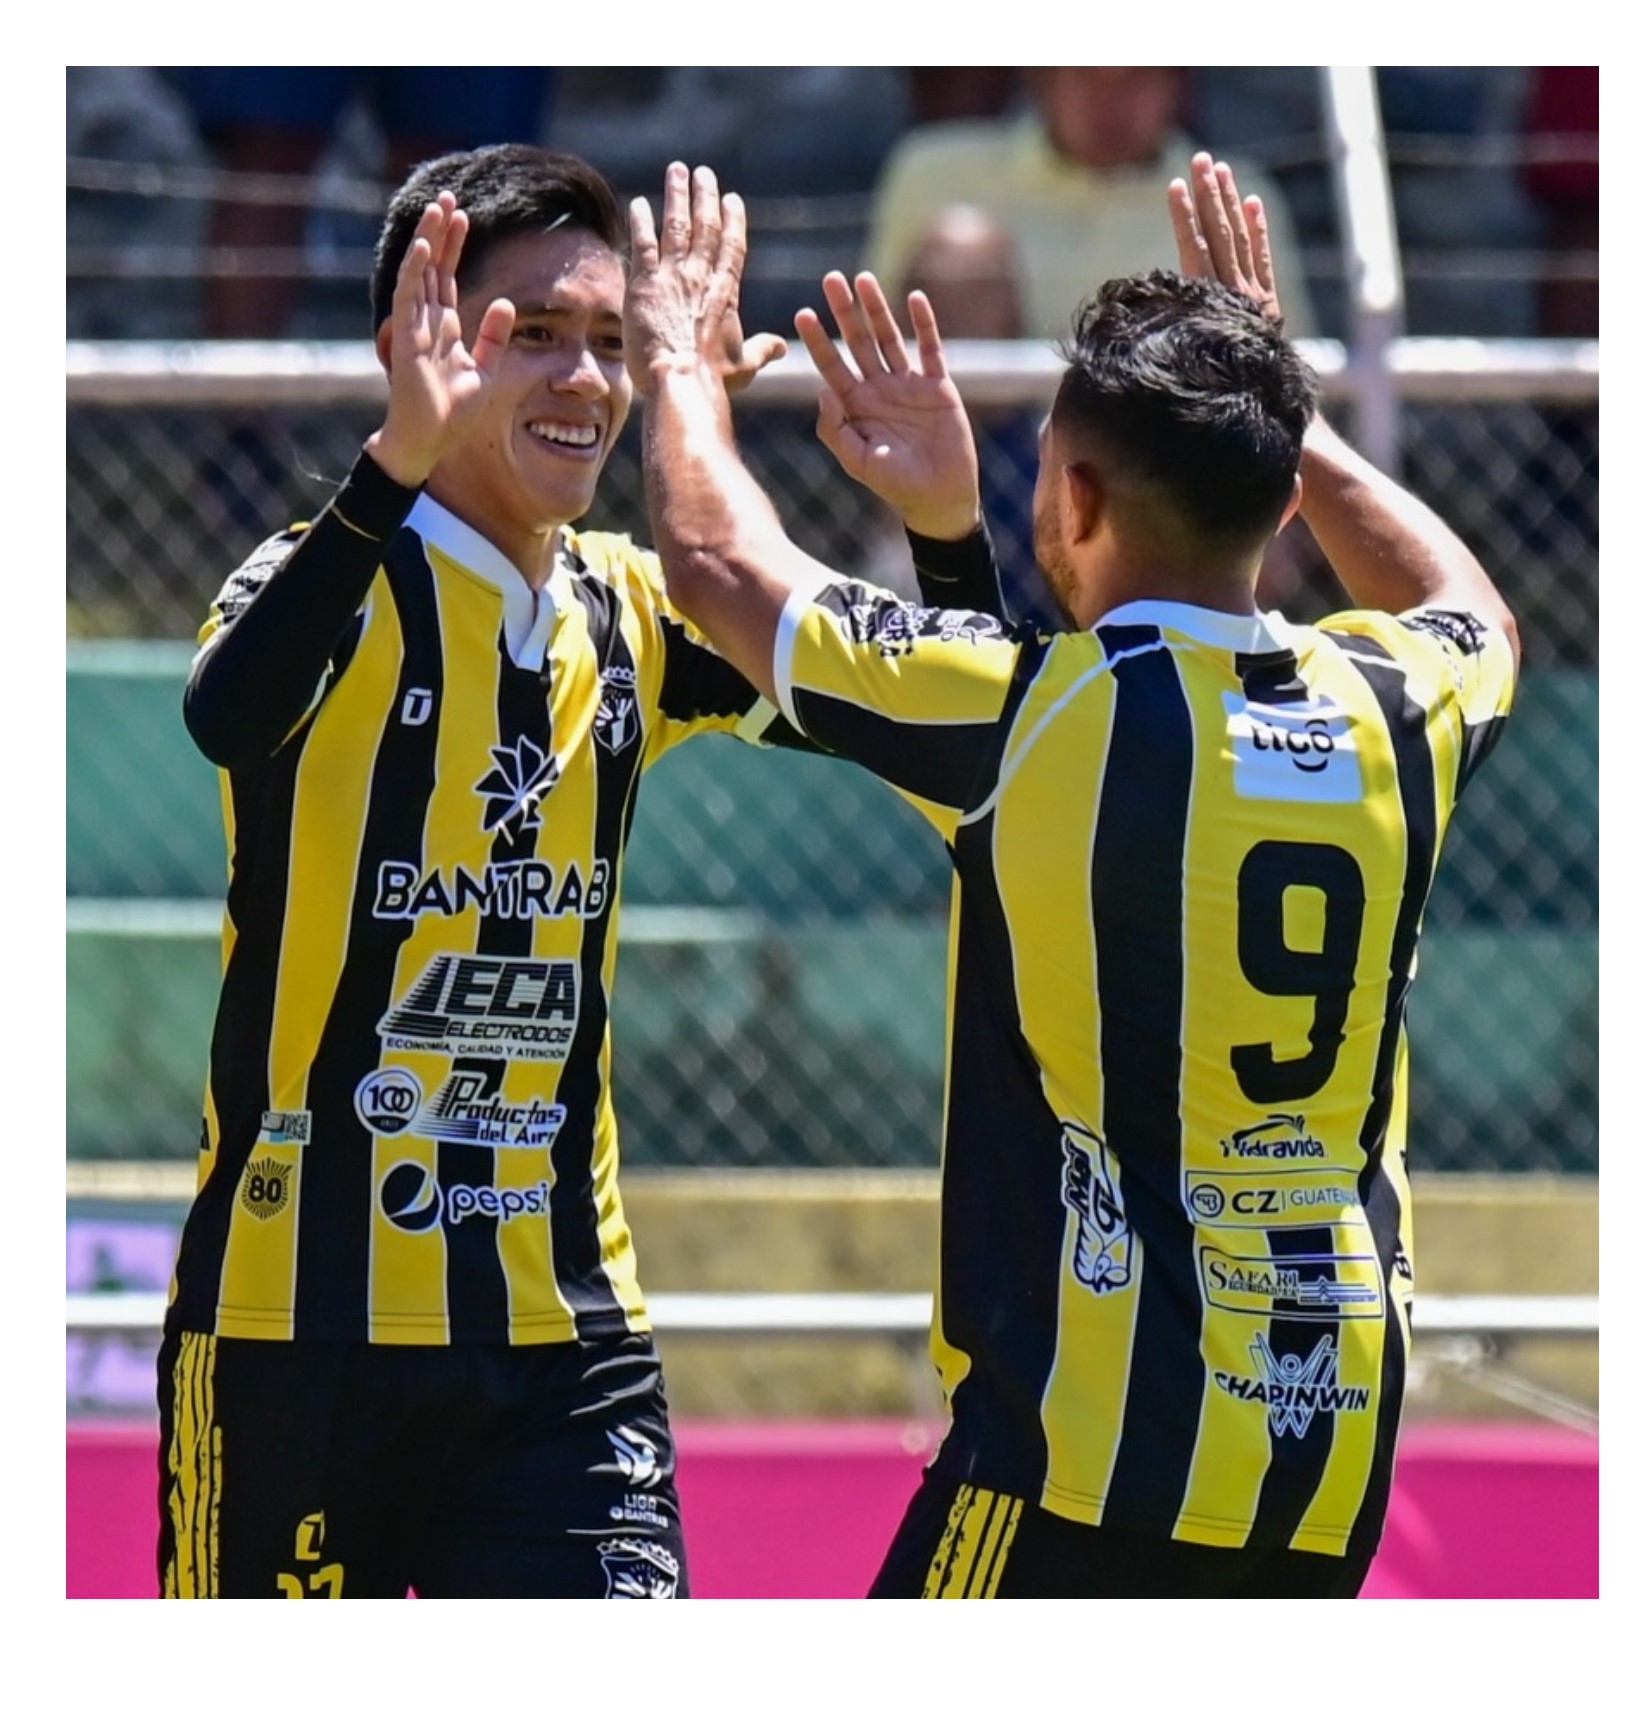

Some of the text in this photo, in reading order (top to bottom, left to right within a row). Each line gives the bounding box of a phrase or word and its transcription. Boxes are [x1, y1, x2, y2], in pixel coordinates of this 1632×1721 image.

[372, 861, 610, 919] BANTRAB
[1230, 839, 1366, 1104] 9
[447, 1021, 573, 1044] ELECTRODOS
[368, 1085, 415, 1114] 100
[249, 1174, 282, 1204] 80
[450, 1183, 549, 1221] pepsi
[1232, 1190, 1279, 1214] CZ
[1209, 1260, 1299, 1290] SAFARI
[1214, 1371, 1370, 1411] CHAPINWIN
